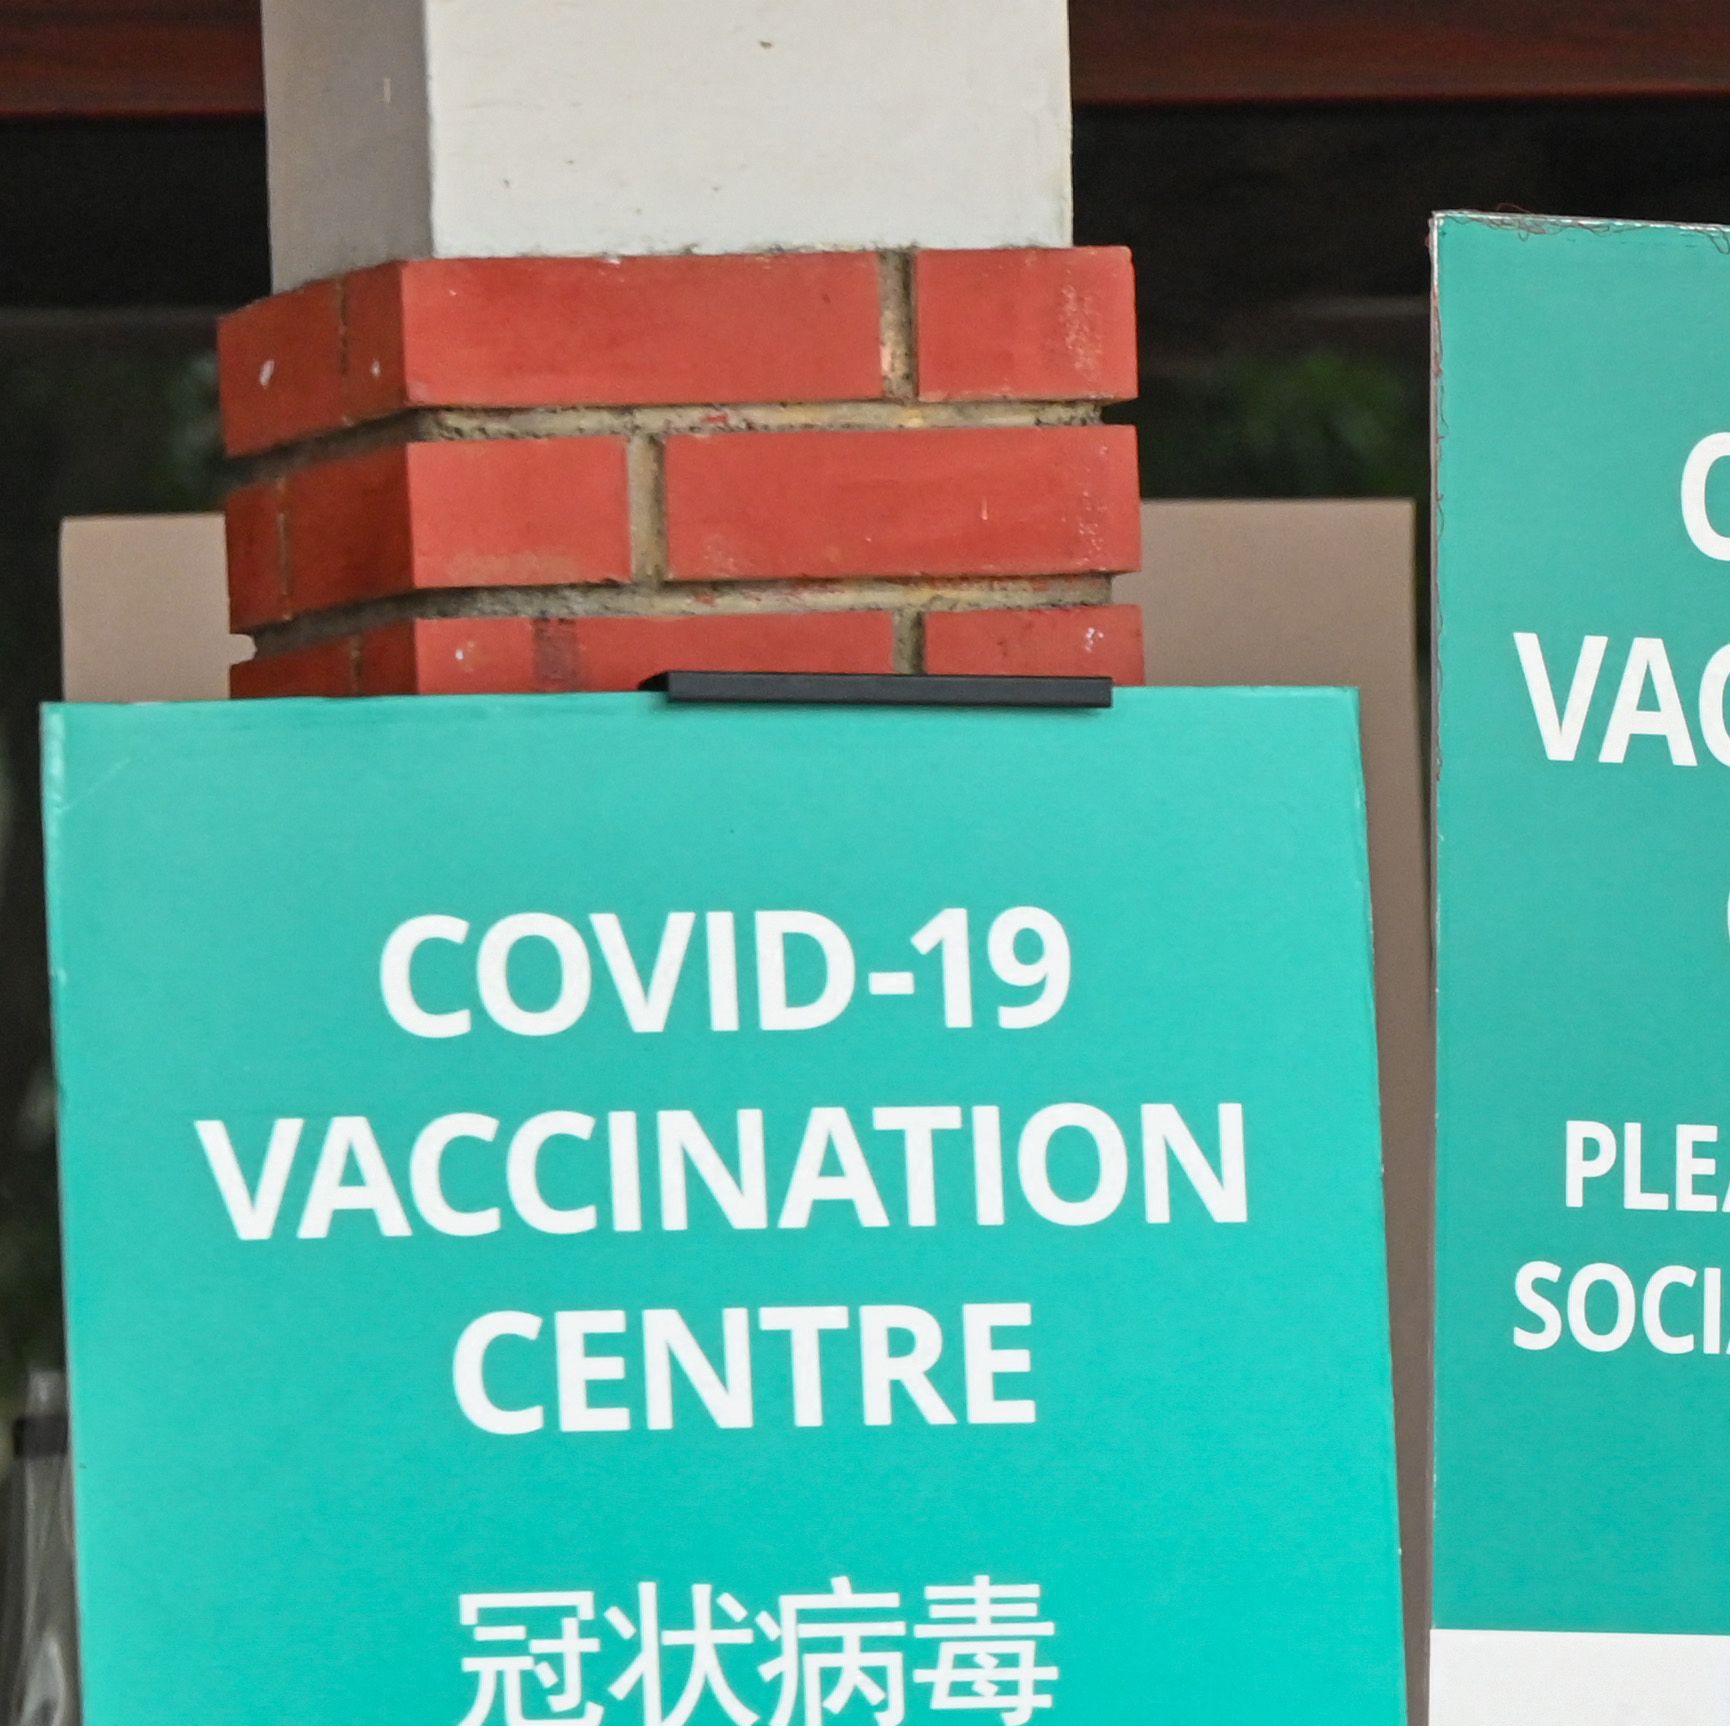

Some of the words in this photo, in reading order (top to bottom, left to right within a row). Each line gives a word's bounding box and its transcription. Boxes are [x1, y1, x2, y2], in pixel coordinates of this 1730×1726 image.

[381, 906, 1072, 1038] COVID-19
[196, 1103, 1248, 1240] VACCINATION
[454, 1303, 1037, 1434] CENTRE
